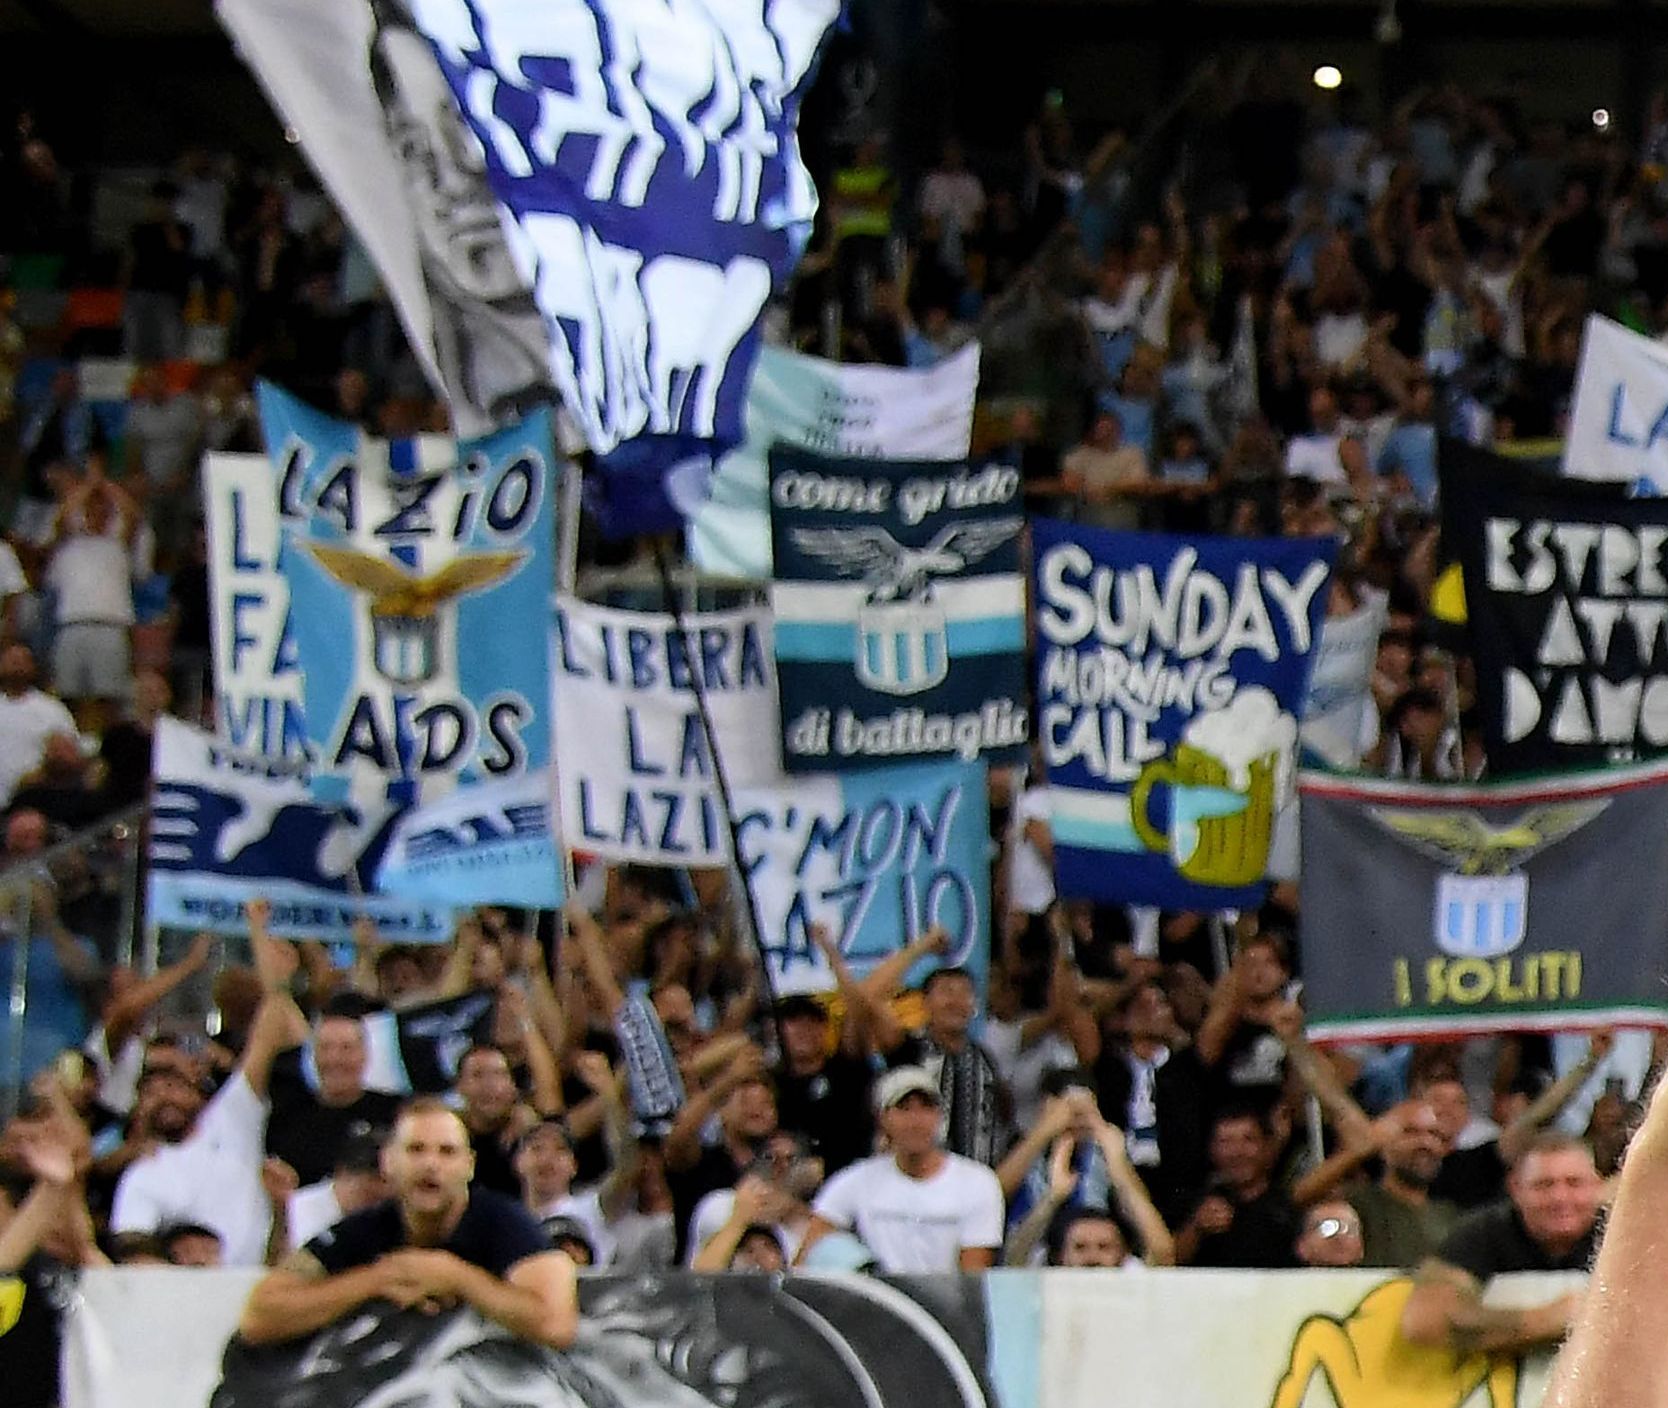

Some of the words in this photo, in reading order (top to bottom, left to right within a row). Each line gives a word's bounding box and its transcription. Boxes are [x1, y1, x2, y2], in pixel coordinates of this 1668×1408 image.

[771, 468, 892, 514] come
[1039, 543, 1331, 663] SUNDAY
[557, 612, 768, 690] LIBERA
[1042, 643, 1238, 712] MORNING
[626, 703, 702, 777] LA
[787, 707, 832, 757] di
[1394, 956, 1413, 1008] I
[1425, 949, 1584, 1007] SOLITI
